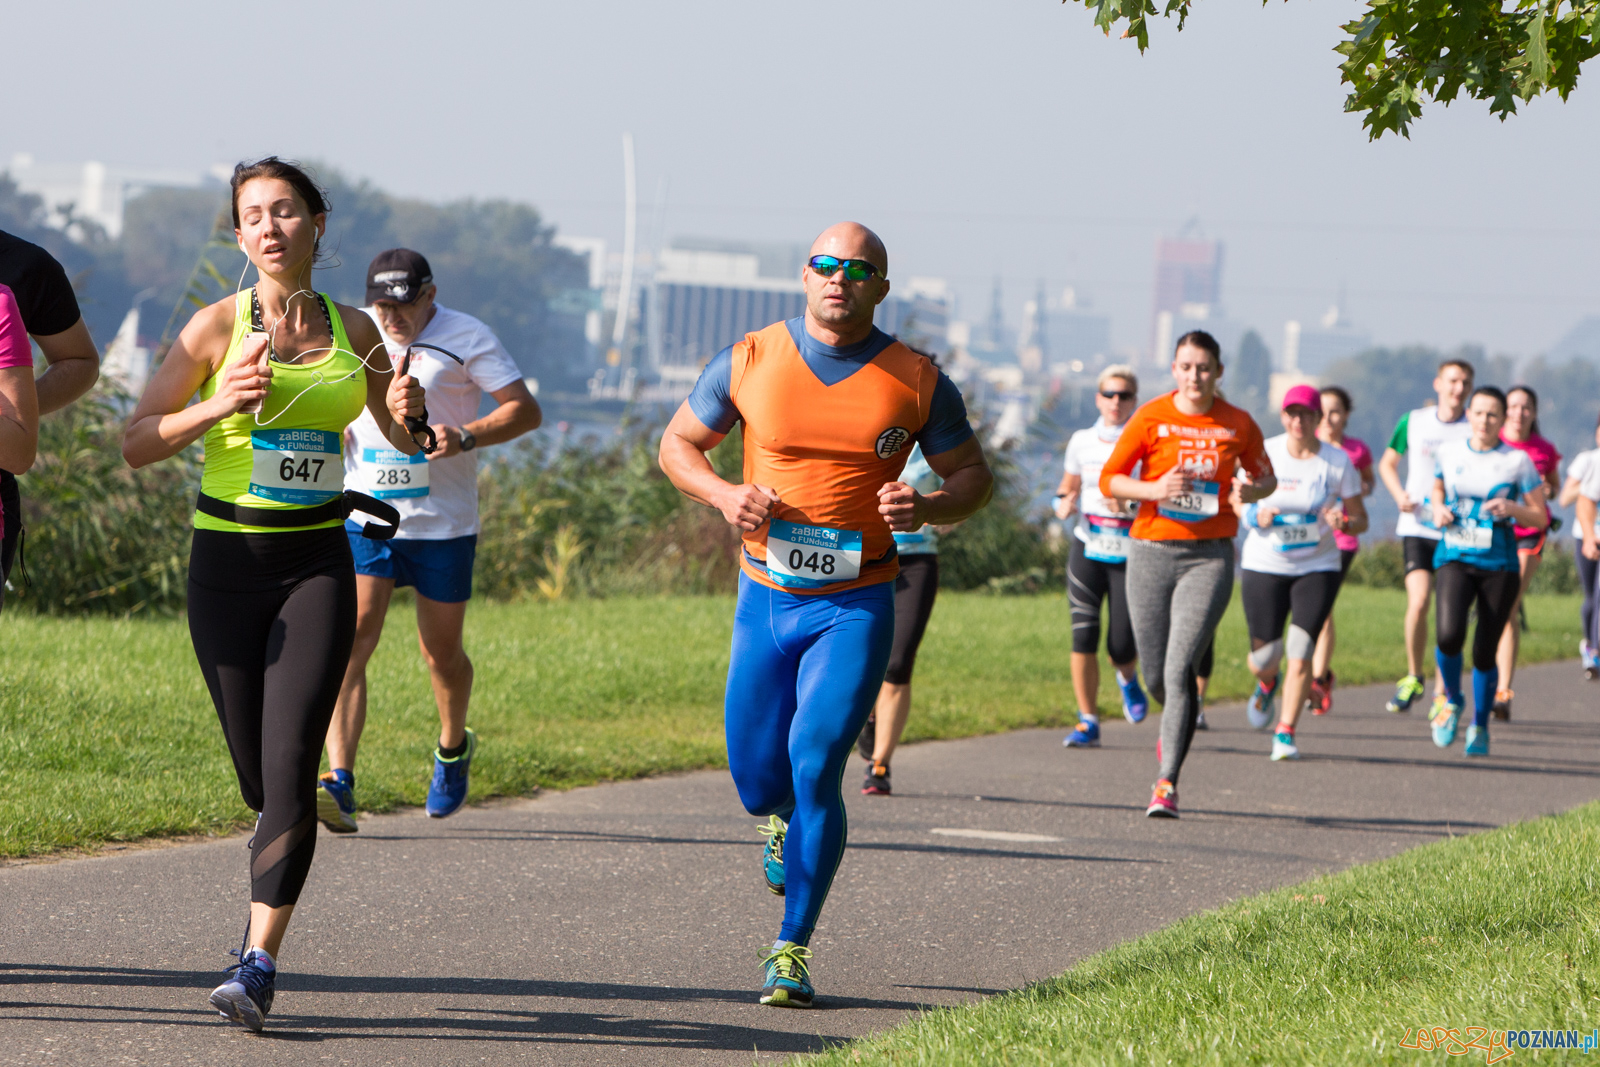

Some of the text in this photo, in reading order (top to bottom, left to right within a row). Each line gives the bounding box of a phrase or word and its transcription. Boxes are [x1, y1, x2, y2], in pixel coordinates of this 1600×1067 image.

[279, 431, 324, 444] zaBIEGaj
[287, 442, 324, 451] FUNdusze
[280, 457, 325, 482] 647
[376, 468, 411, 485] 283
[791, 526, 839, 542] zaBIEGaj
[798, 536, 838, 548] FUNdusze
[788, 548, 836, 575] 048
